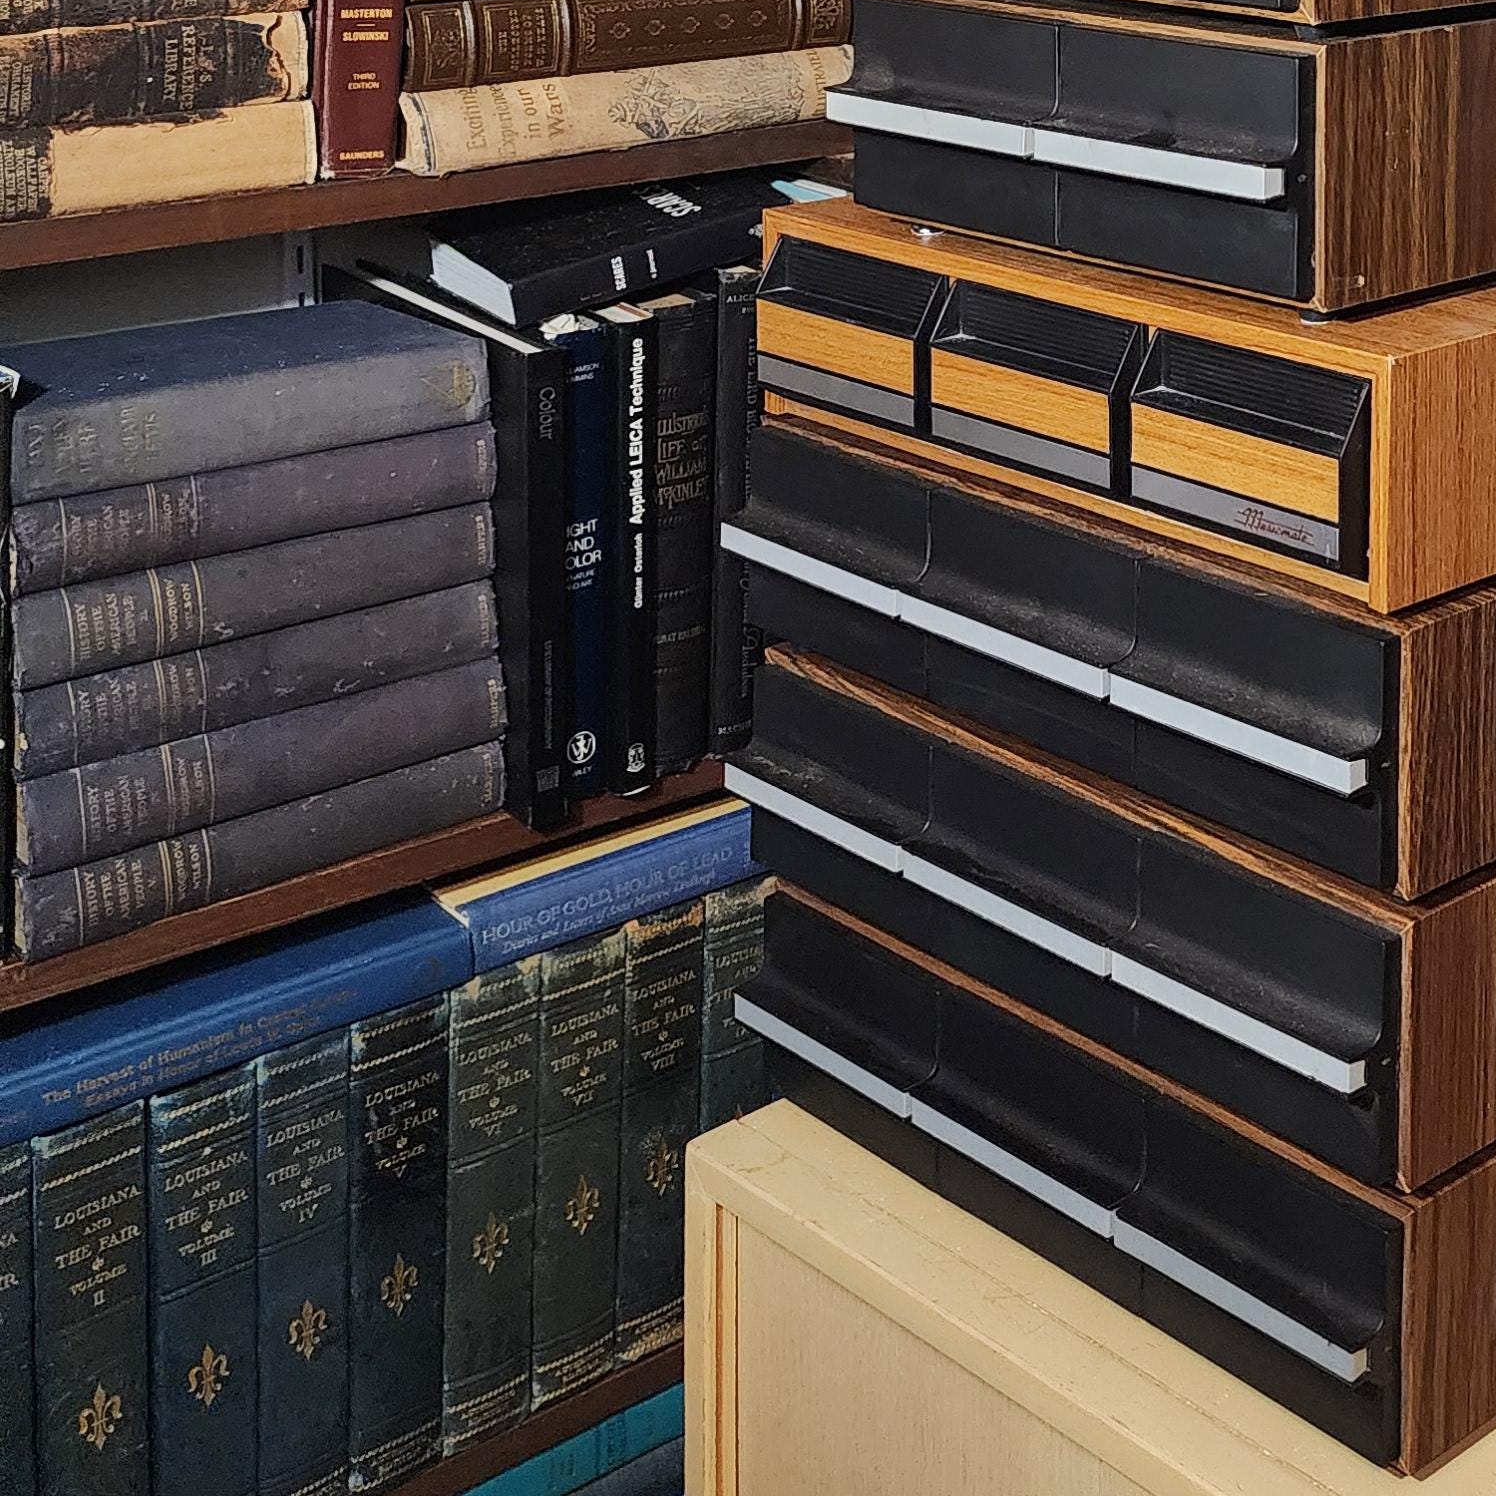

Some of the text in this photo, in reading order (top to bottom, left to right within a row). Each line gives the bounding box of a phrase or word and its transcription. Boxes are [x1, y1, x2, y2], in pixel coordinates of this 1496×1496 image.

[340, 7, 393, 20] MASTERTON
[342, 30, 389, 42] SLOWINSKI
[339, 150, 385, 161] SAUNDERS
[539, 387, 555, 439] Colour
[629, 337, 644, 525] Technique LEICA Applied
[565, 536, 595, 553] AND
[83, 871, 98, 927] HISTORY
[115, 858, 130, 918] AMERICAN
[551, 1003, 619, 1038] LOUISIANA
[550, 1037, 619, 1073] THE FAIR
[266, 1109, 344, 1148] LOUISIANA
[164, 1150, 248, 1192] LOUISIANA
[266, 1145, 346, 1186] THE FAIR
[54, 1184, 142, 1230] LOUISIANA
[192, 1180, 221, 1199] AND
[83, 1217, 112, 1235] AND
[165, 1188, 249, 1231] THE FAIR
[54, 1225, 142, 1270] THE FAIR
[178, 1226, 234, 1256] VOLUME
[69, 1265, 128, 1296] VOLUME
